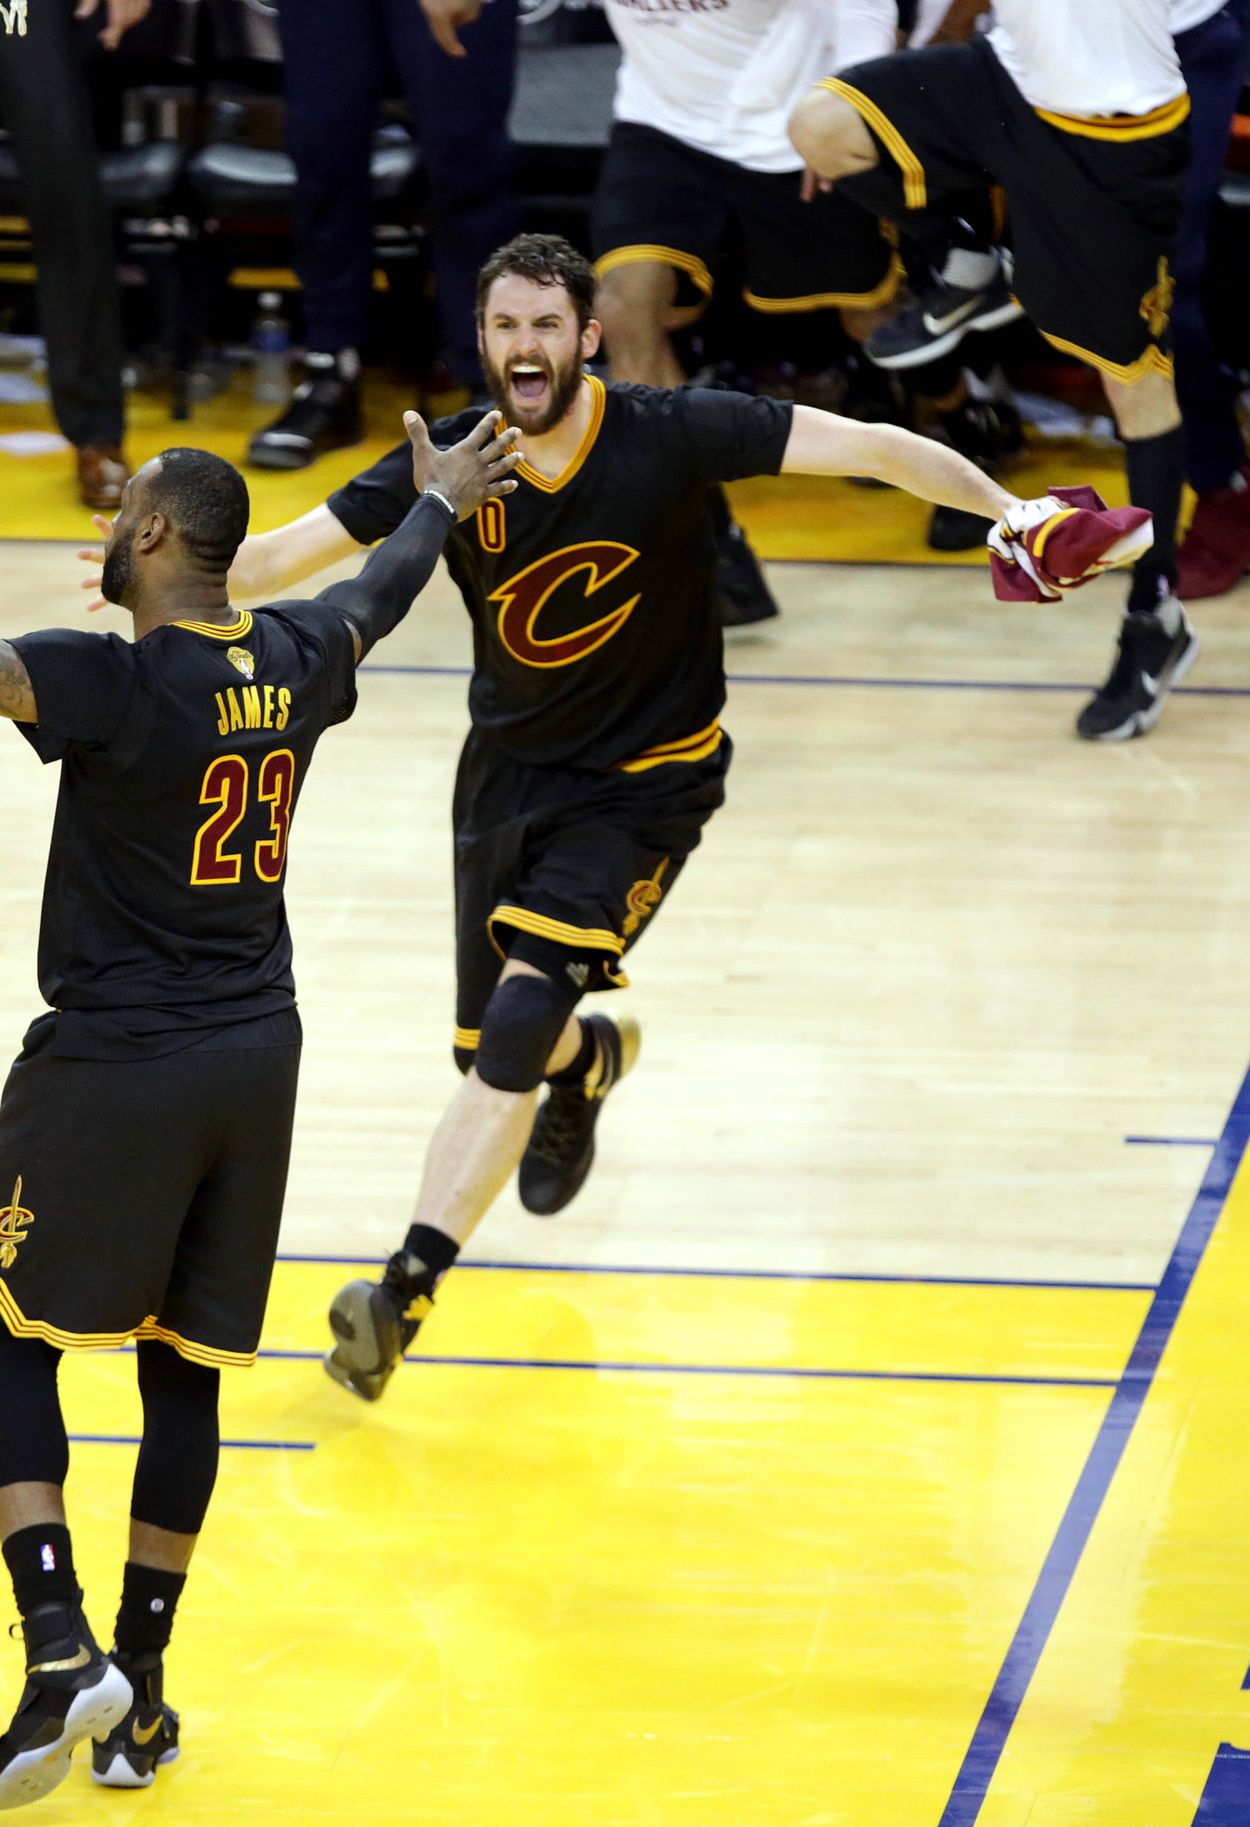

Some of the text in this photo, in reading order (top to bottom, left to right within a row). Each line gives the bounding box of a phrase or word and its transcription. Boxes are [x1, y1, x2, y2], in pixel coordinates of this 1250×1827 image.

[477, 497, 506, 553] 0
[486, 540, 642, 668] C
[215, 685, 291, 735] JAMES
[190, 748, 295, 885] 23
